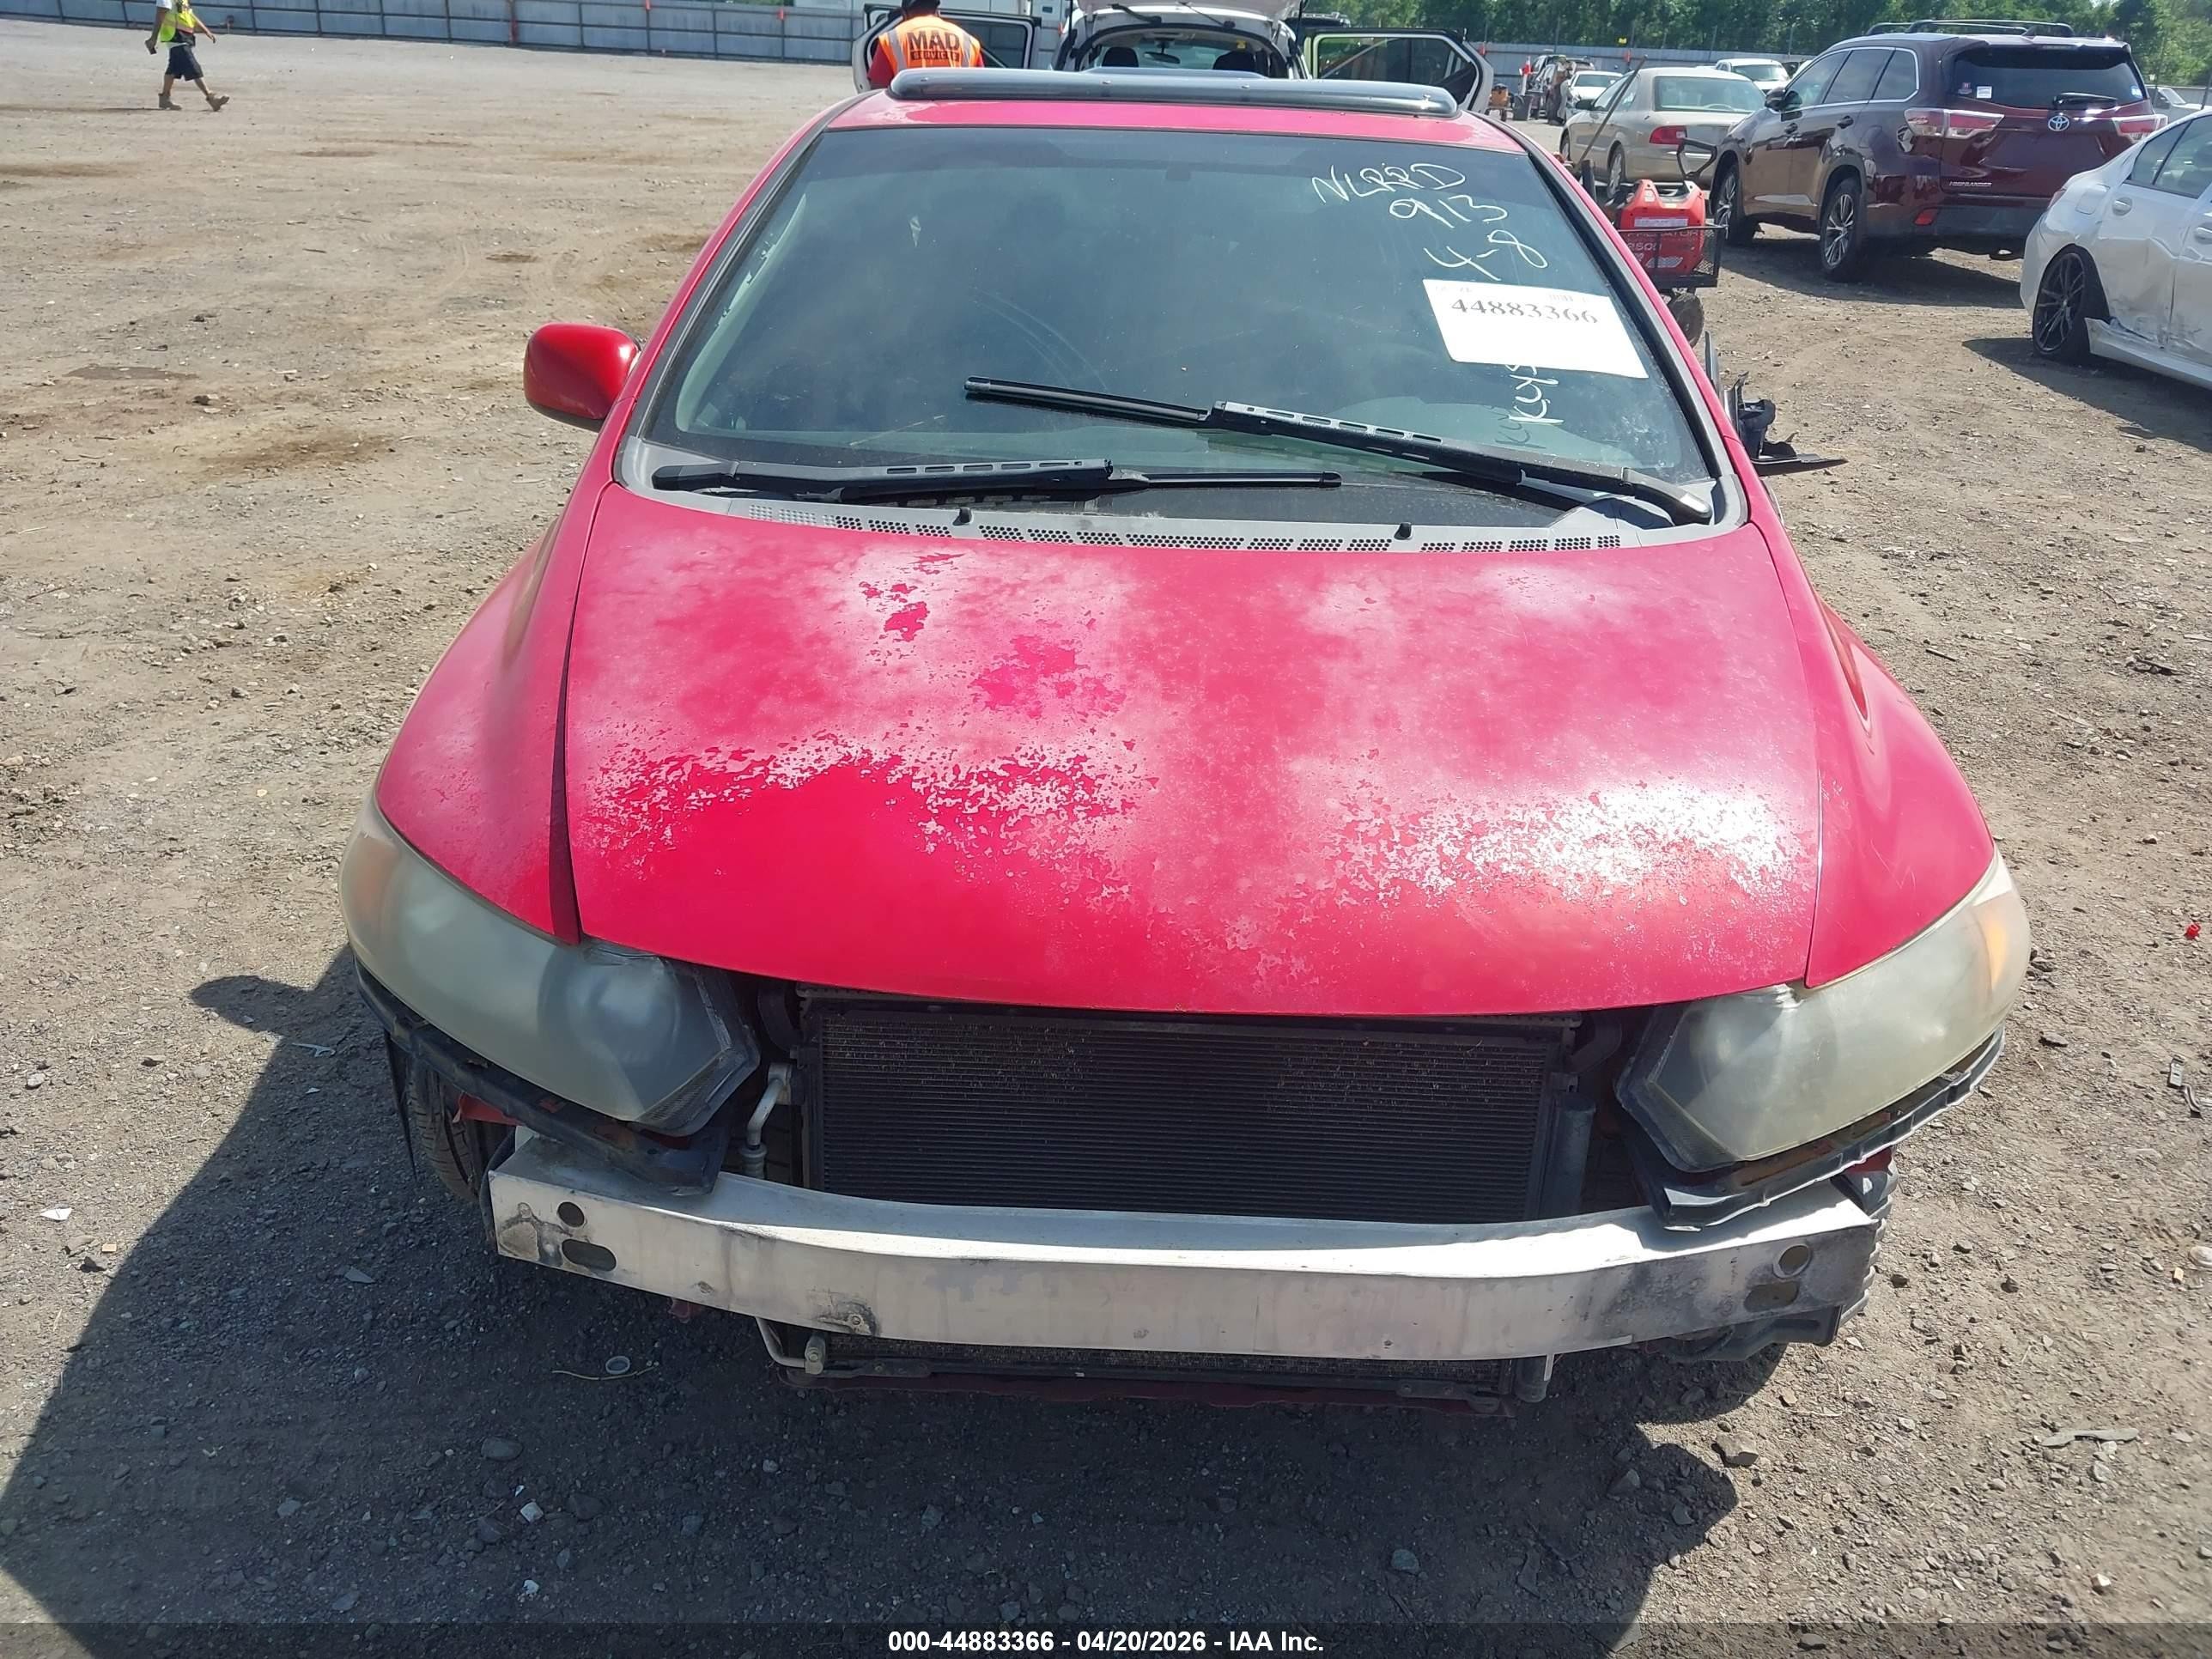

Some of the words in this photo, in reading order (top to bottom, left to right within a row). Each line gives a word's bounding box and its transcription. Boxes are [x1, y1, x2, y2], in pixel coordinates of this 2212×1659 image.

[907, 31, 960, 50] MAD
[1389, 194, 1508, 228] 913
[1450, 299, 1598, 324] 44883366
